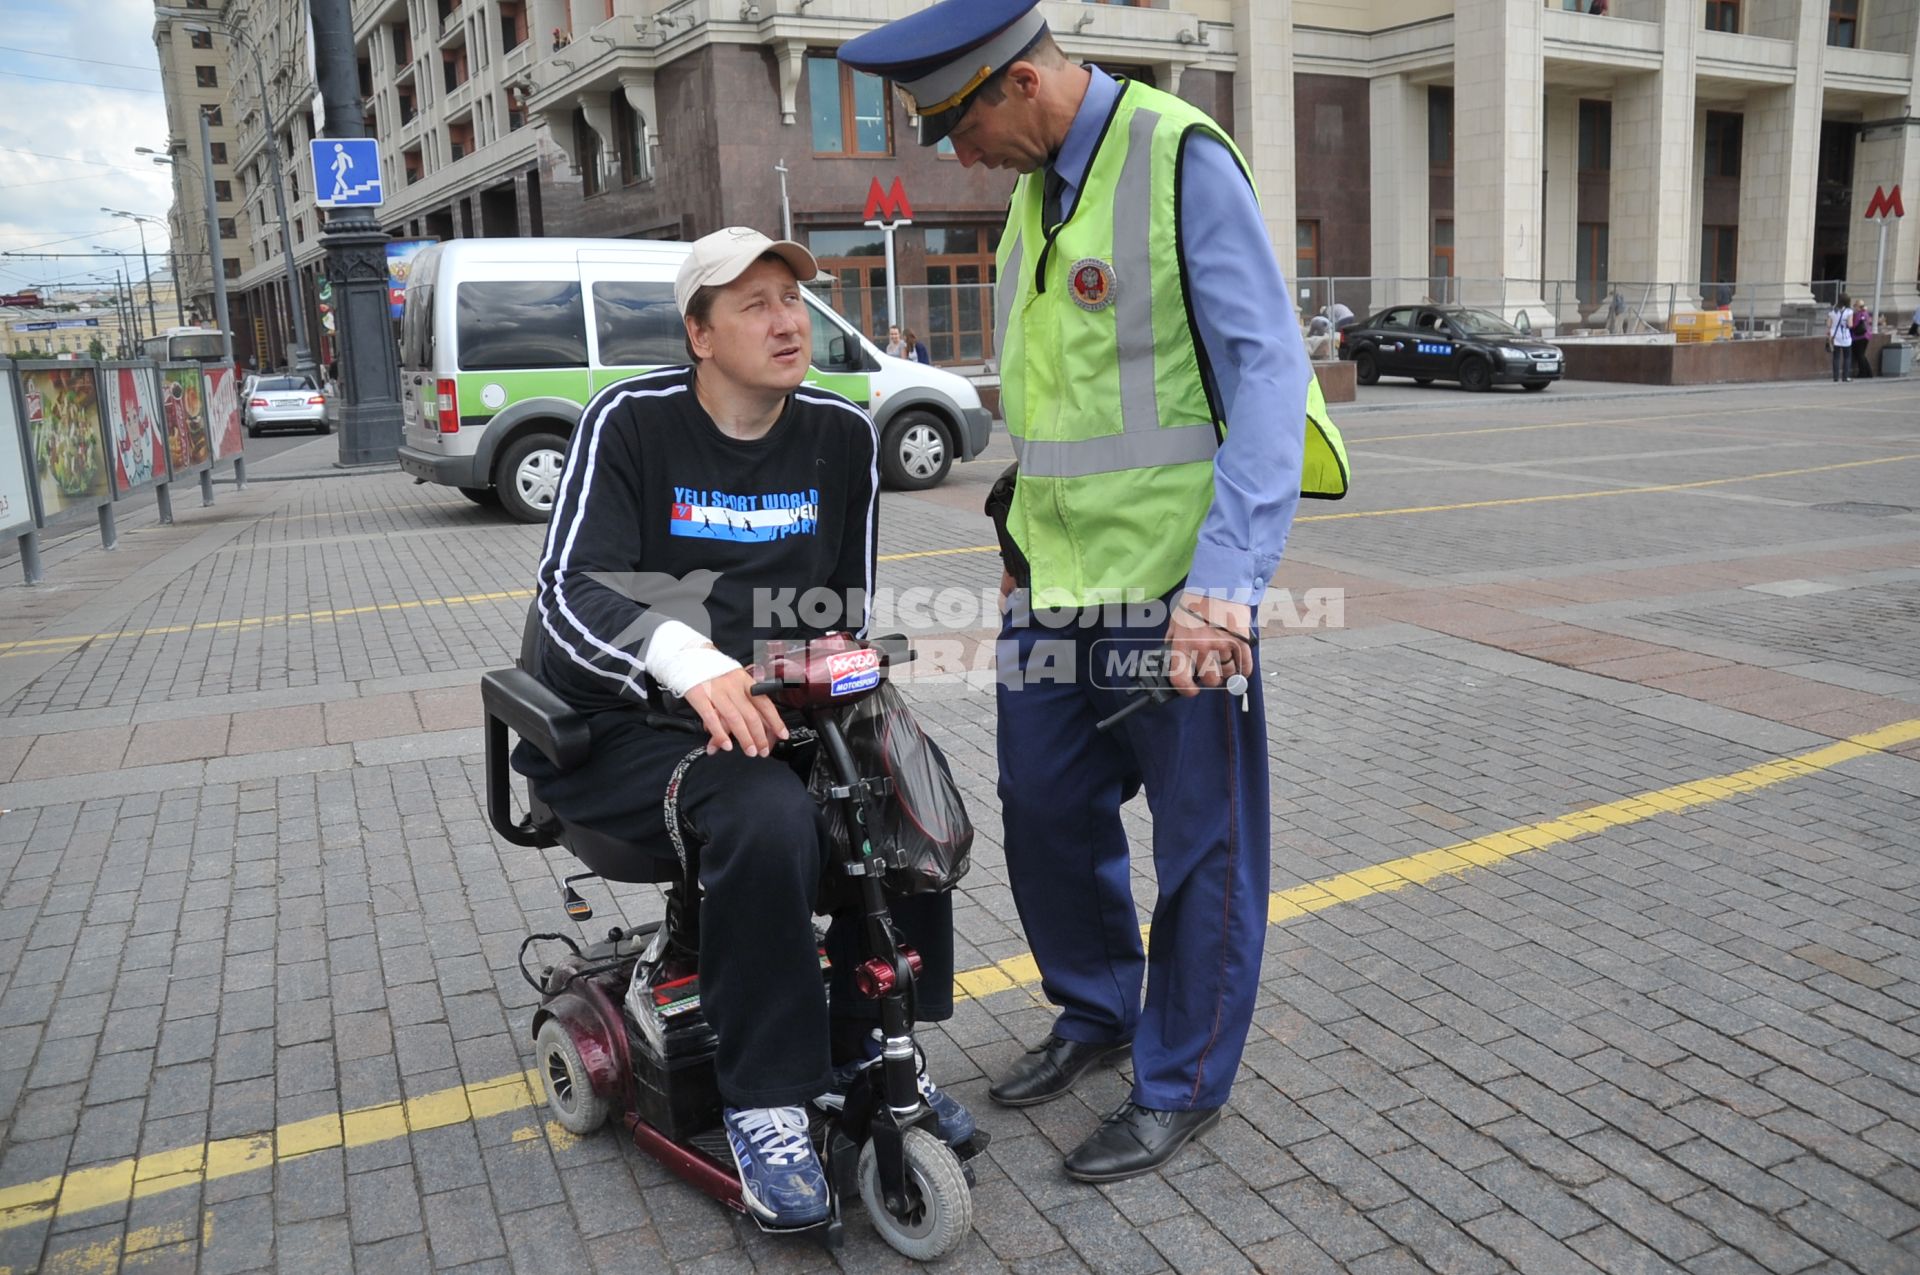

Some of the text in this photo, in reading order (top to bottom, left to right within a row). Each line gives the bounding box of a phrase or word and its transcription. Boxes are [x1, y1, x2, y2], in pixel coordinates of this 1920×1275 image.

[863, 175, 913, 221] М
[1864, 184, 1905, 219] М
[1417, 344, 1452, 355] ВЕСТИ
[673, 486, 819, 513] YELI SPORT WORLD
[835, 676, 877, 692] MOTORSPORT
